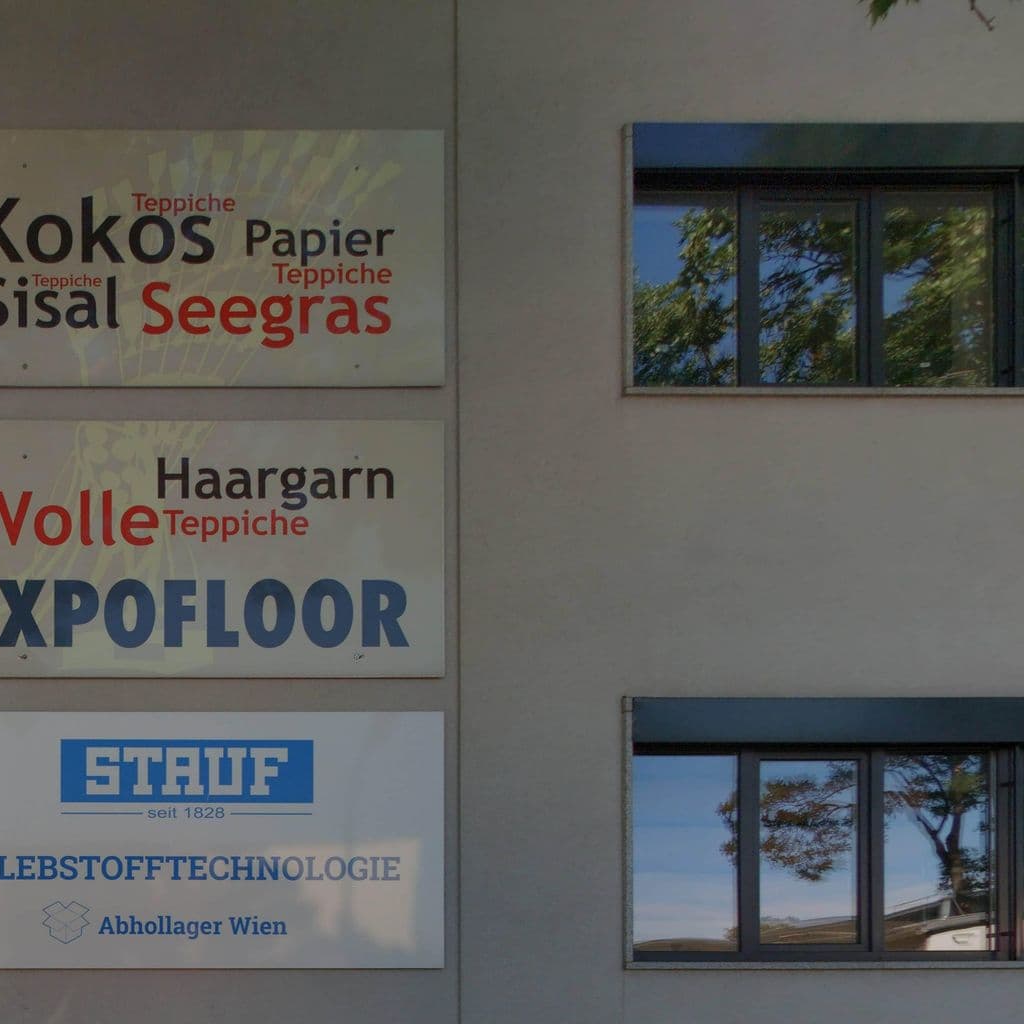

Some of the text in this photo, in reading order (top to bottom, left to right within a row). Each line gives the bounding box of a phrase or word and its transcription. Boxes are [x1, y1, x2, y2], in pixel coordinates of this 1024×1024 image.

[131, 192, 236, 216] Teppiche
[245, 219, 395, 267] Papier
[32, 273, 102, 291] Teppiche
[272, 262, 393, 290] Teppiche
[142, 281, 393, 349] Seegras
[157, 457, 394, 511] Haargarn
[162, 509, 309, 543] Teppiche
[86, 746, 288, 797] STAUF
[147, 806, 225, 820] seit 1828
[98, 915, 288, 939] Abhollager Wien
